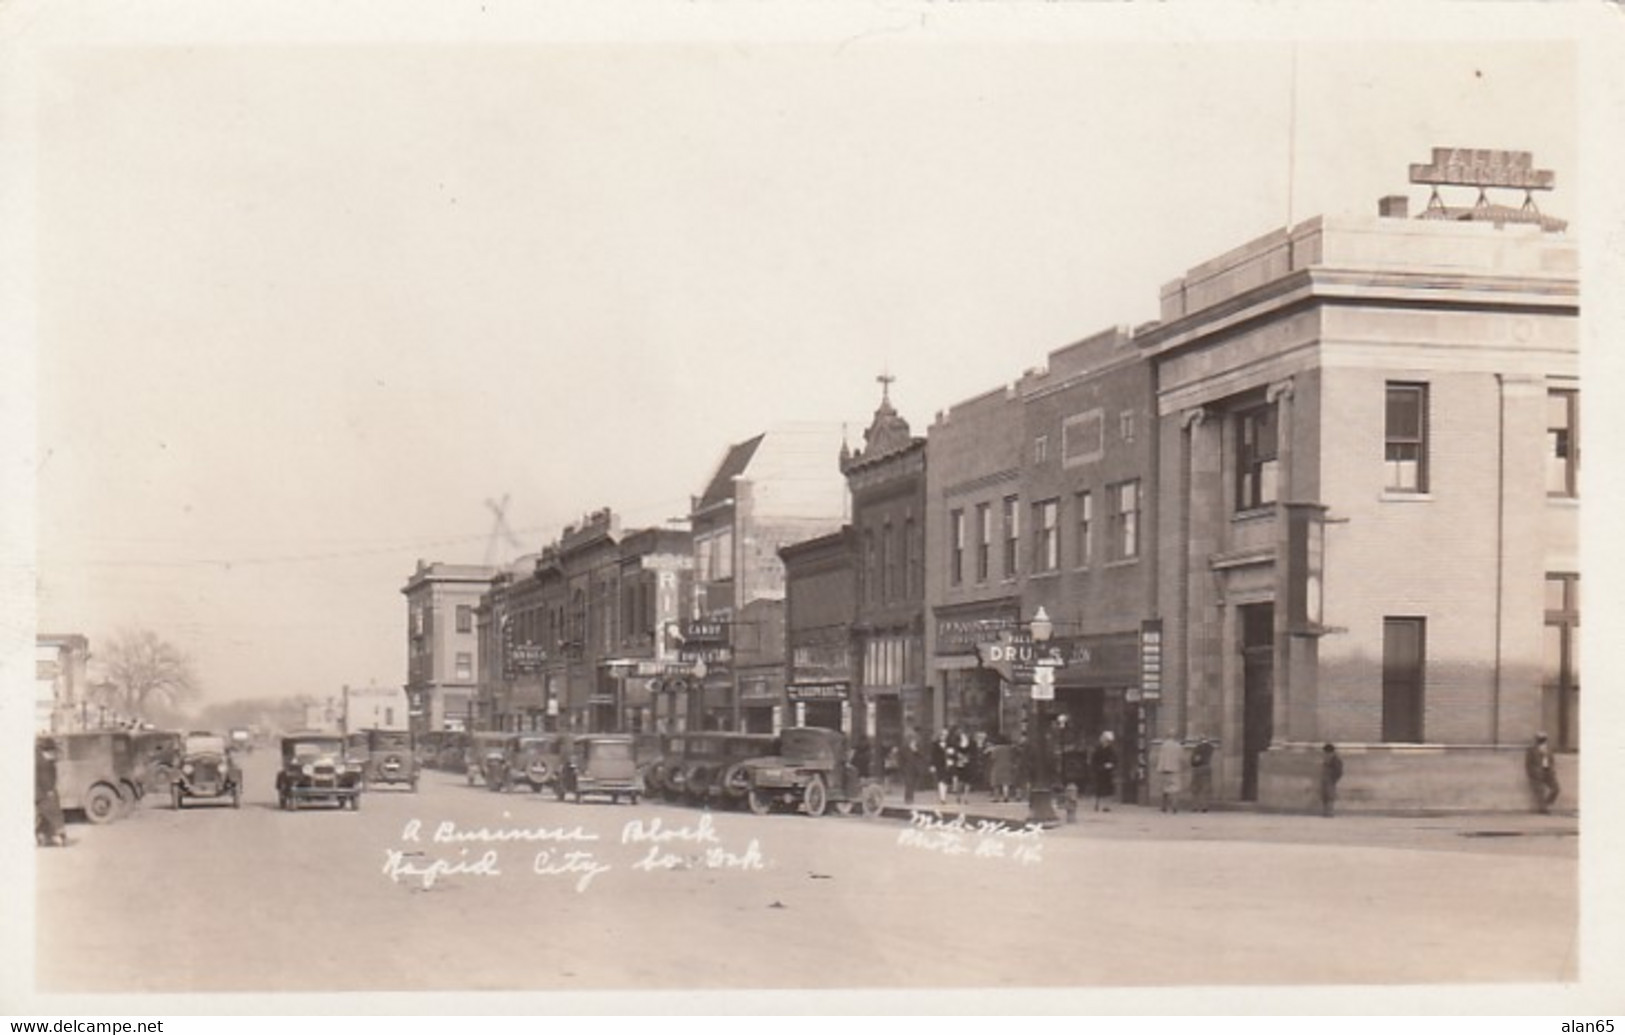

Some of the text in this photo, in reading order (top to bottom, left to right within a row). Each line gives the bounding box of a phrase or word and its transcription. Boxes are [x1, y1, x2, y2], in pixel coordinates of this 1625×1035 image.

[989, 645, 1061, 663] DRUS
[433, 811, 599, 843] Business
[622, 814, 720, 844] Block
[382, 848, 501, 888] Rapid
[534, 846, 611, 892] City
